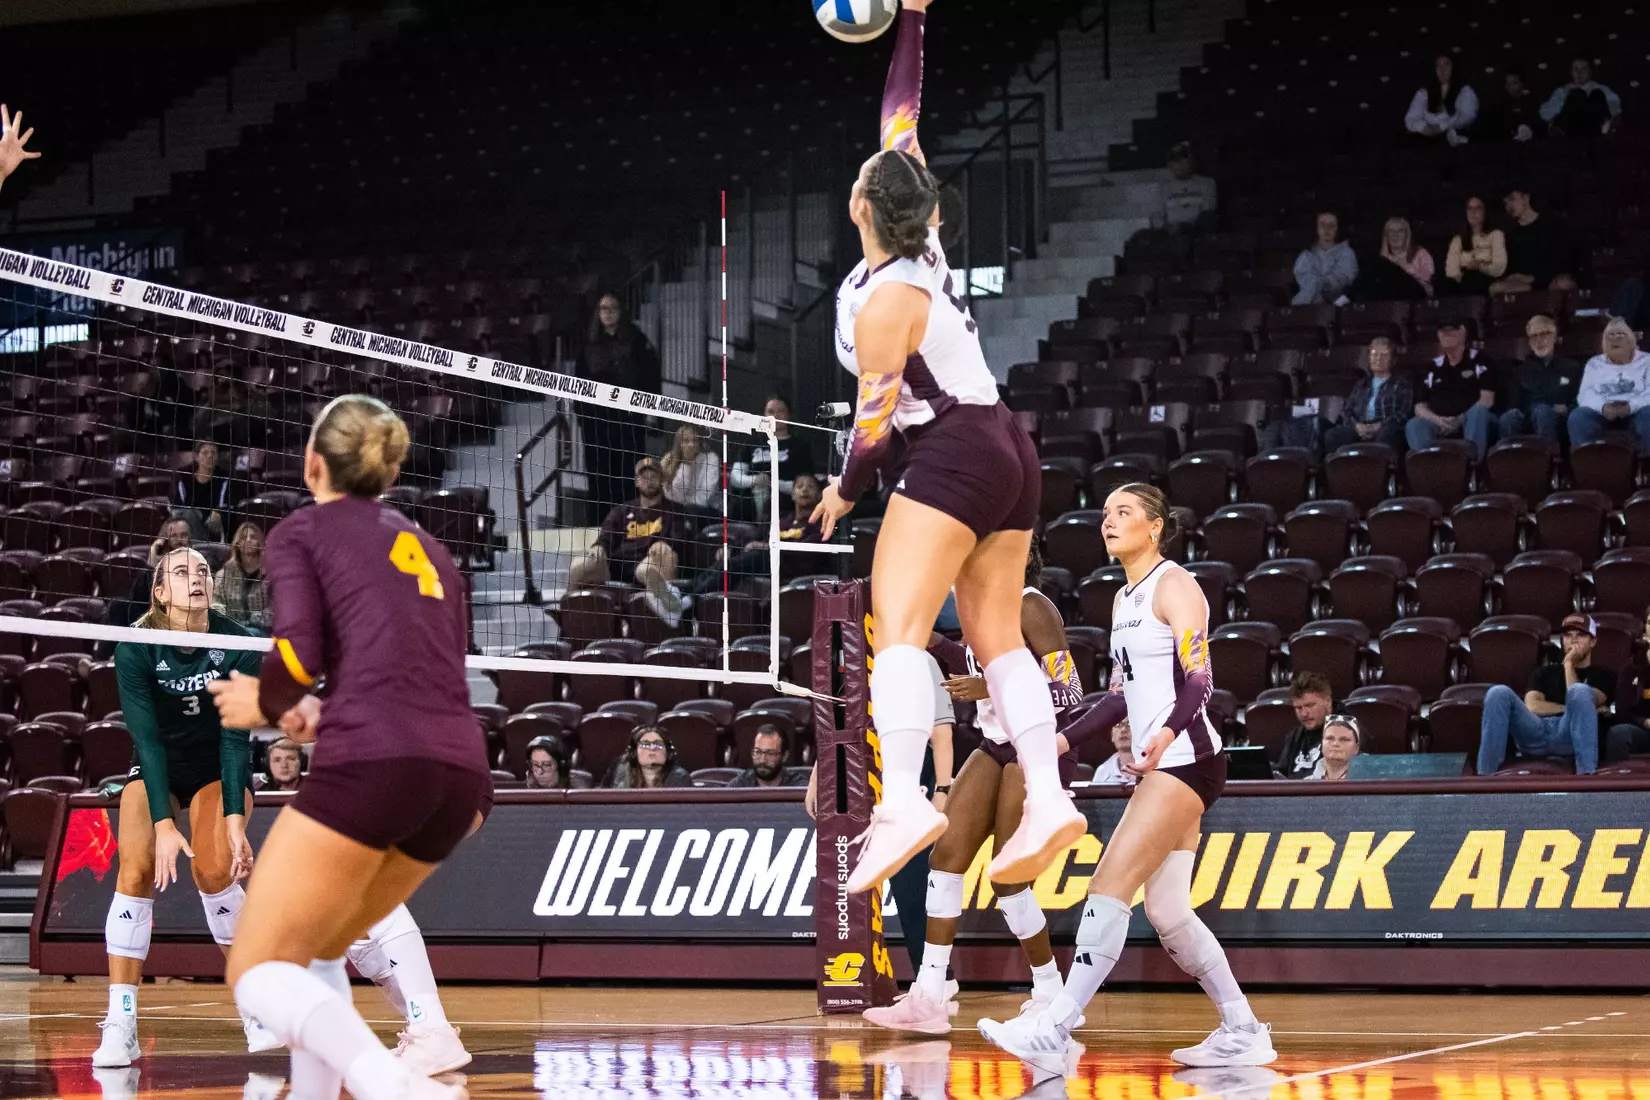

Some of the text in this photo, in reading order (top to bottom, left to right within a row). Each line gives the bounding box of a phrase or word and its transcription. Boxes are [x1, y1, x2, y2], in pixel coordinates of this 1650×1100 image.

[29, 258, 91, 290] VOLLEYBALL
[142, 285, 287, 332] CENTRAL MICHIGAN VOLLEYBALL
[330, 326, 454, 367] CENTRAL MICHIGAN VOLLEYBALL
[491, 361, 598, 398] CENTRAL MICHIGAN VOLLEYBALL
[630, 391, 725, 424] CENTRAL MICHIGAN VOLLEYBALL
[389, 531, 444, 600] 4
[181, 695, 201, 716] 3
[835, 835, 850, 940] sports imports
